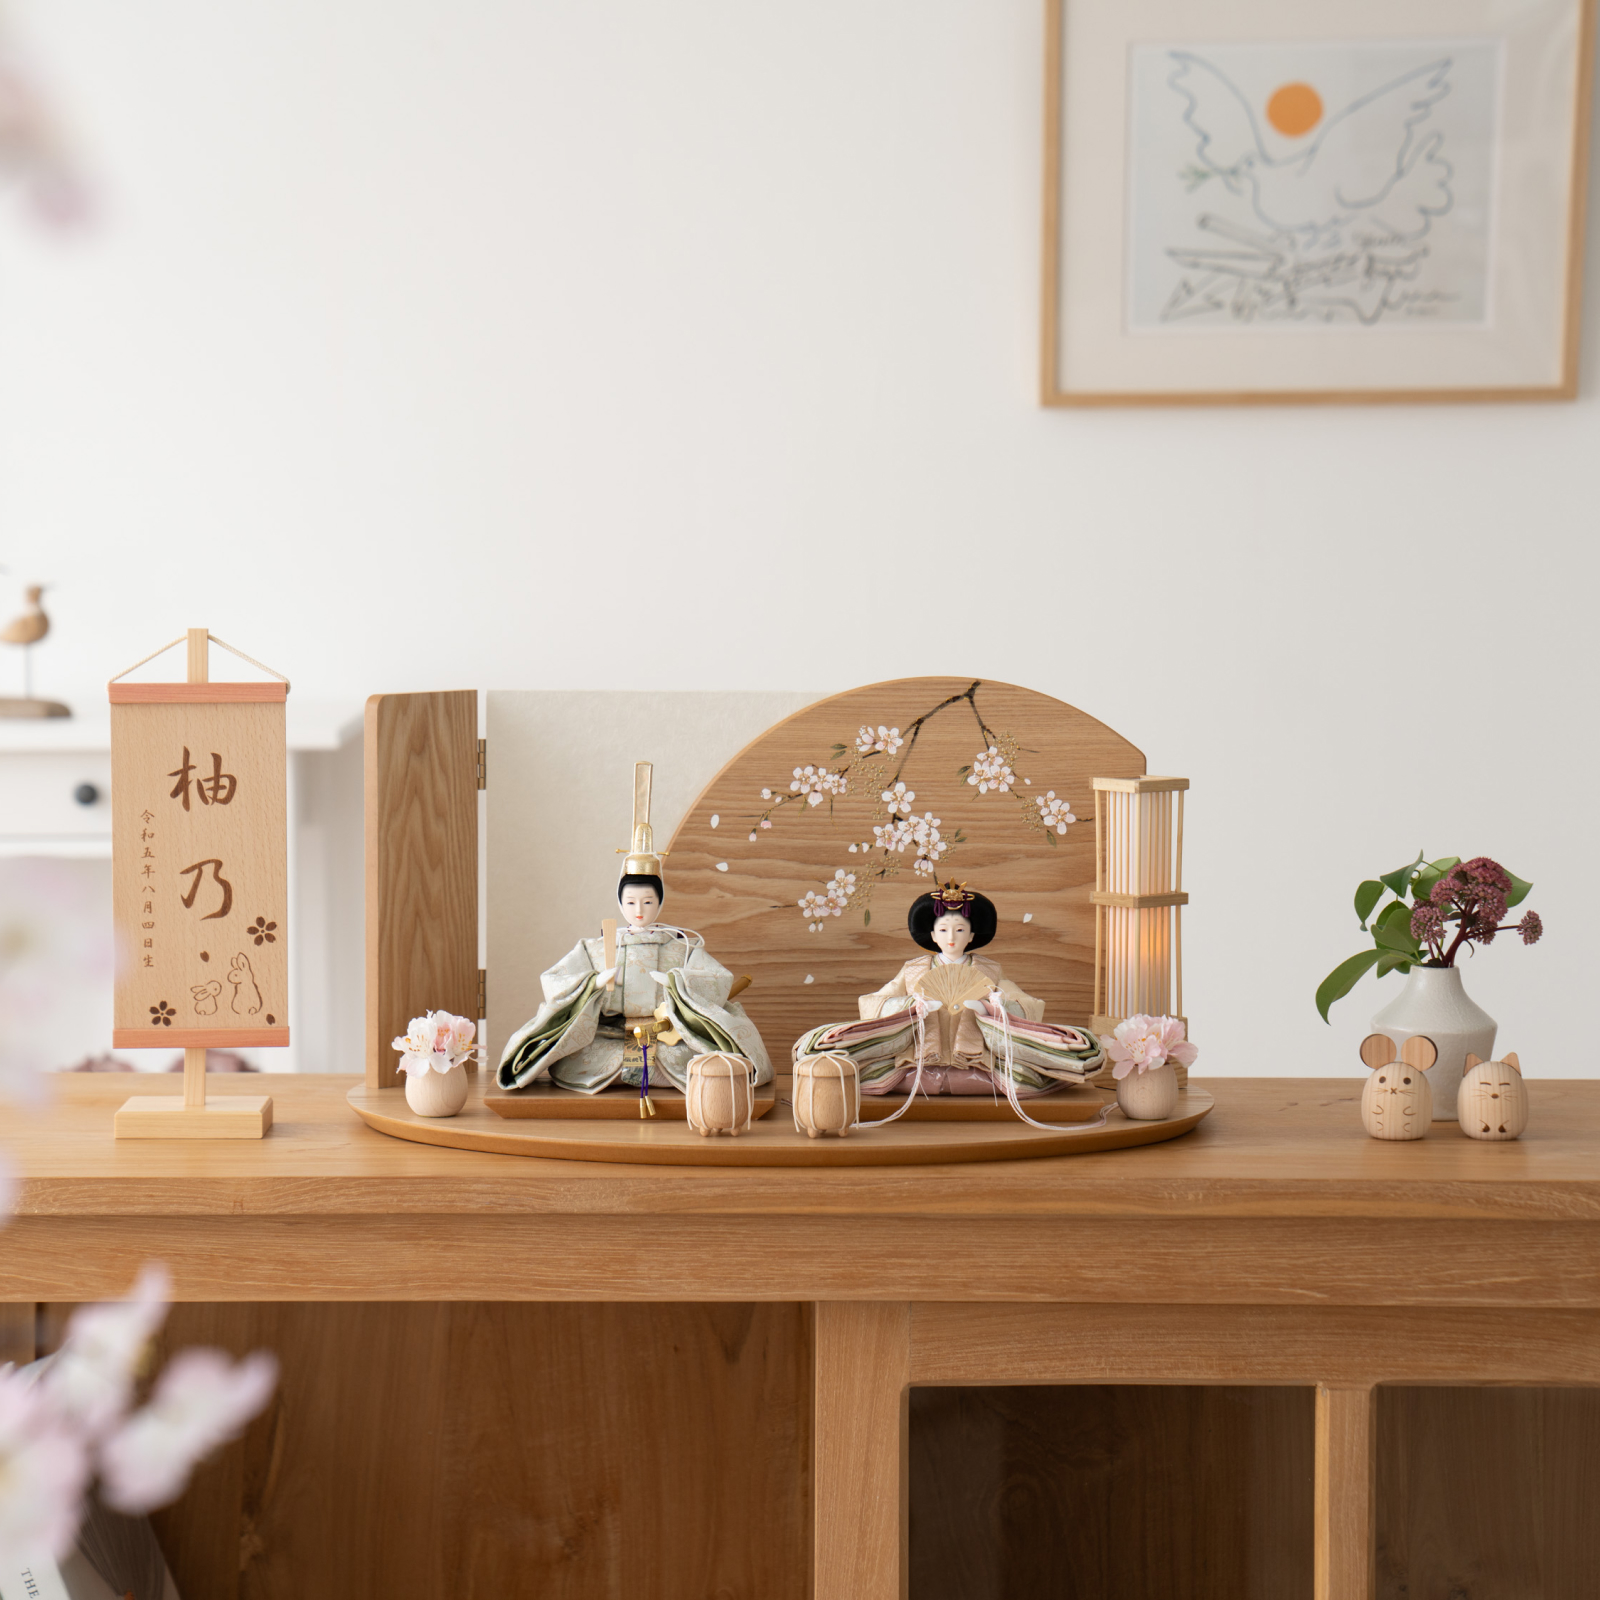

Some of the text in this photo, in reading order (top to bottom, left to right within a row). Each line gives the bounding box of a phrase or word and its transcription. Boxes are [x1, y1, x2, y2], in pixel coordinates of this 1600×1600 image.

[140, 809, 156, 968] 令和五年八月四日生
[166, 745, 237, 921] 柚乃
[20, 1567, 40, 1599] THE
